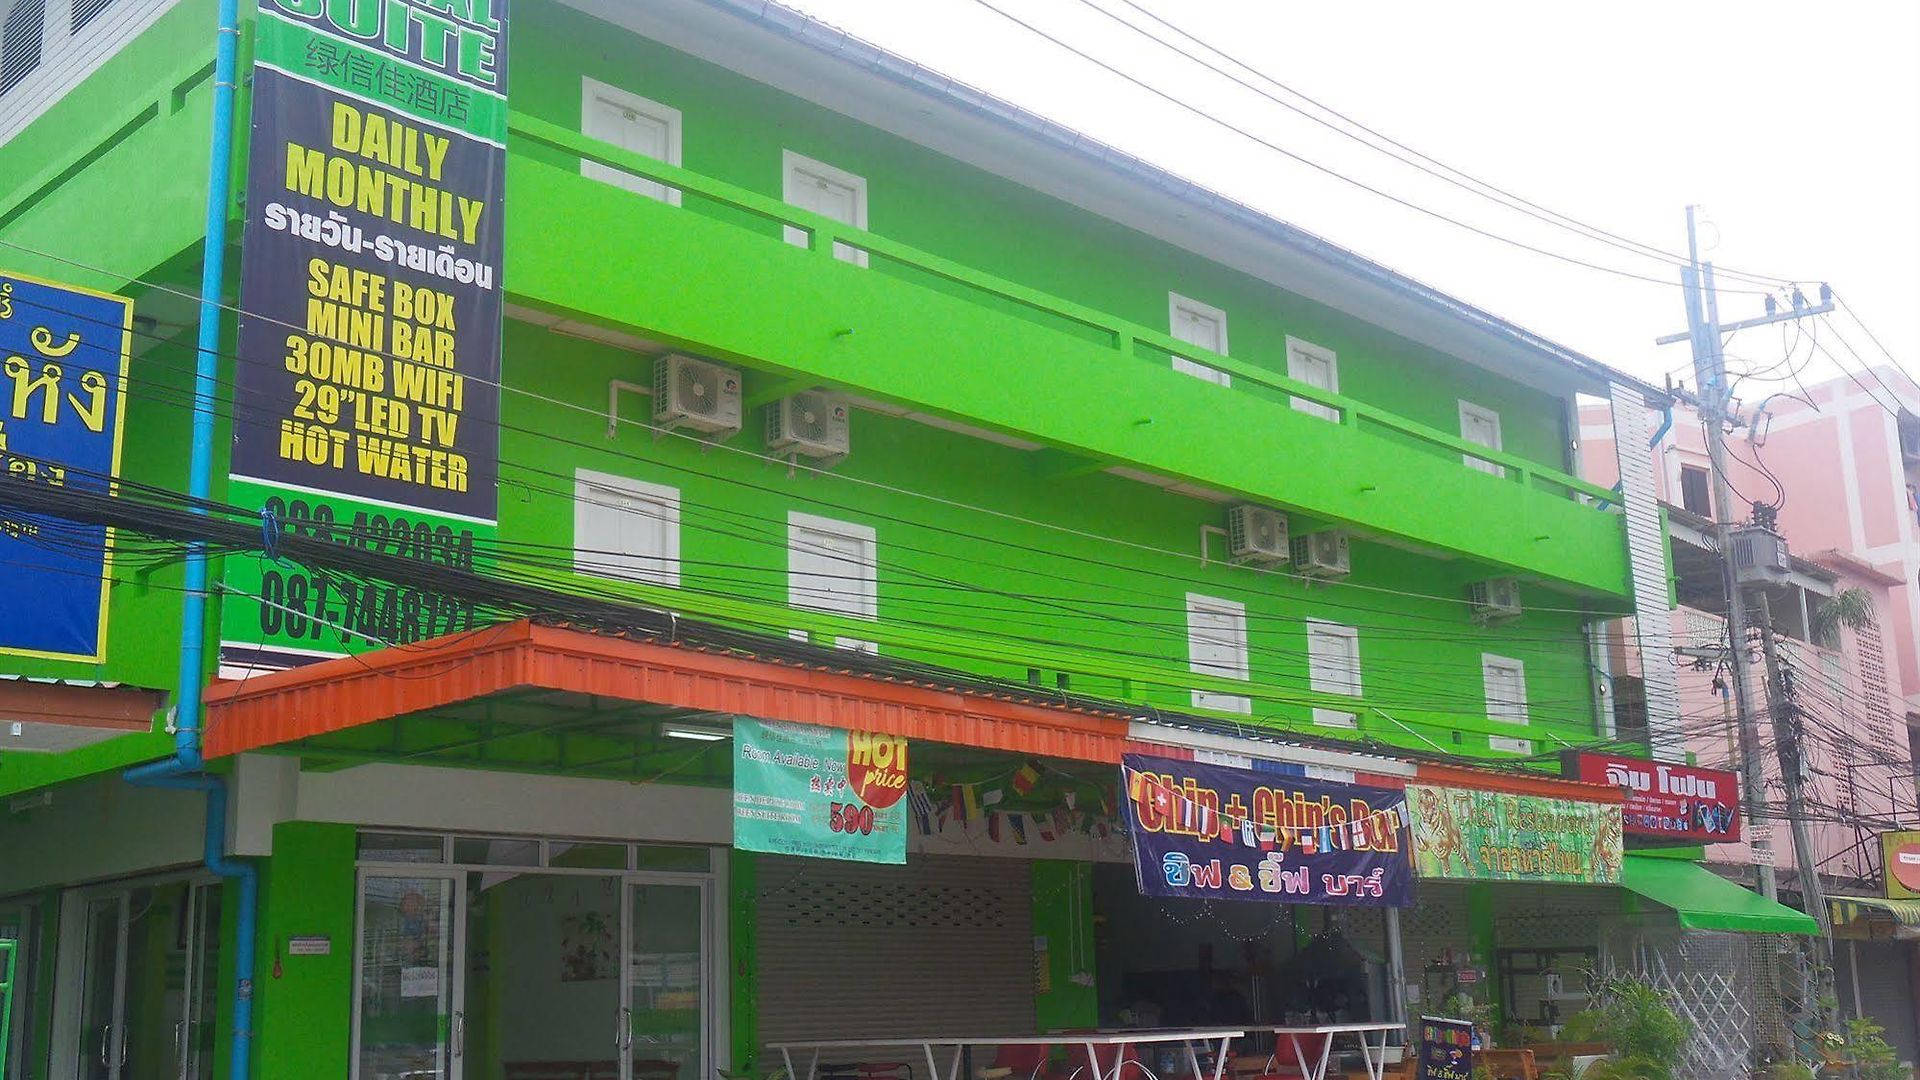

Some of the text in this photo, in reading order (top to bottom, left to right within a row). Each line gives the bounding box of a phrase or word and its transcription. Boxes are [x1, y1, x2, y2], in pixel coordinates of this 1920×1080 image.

[303, 37, 471, 124] 绿信佳酒店
[332, 101, 449, 181] DAILY
[285, 142, 484, 245] MONTHLY
[264, 202, 493, 290] รายวัน-รายเดือน
[308, 258, 455, 331] SAFE BOX
[307, 299, 455, 369] MINI BAR
[285, 335, 463, 412] 30MB WIFI
[279, 419, 468, 492] HOT WATER
[418, 406, 458, 448] TV
[742, 744, 846, 773] Room Available Now
[853, 730, 907, 770] HOT
[860, 769, 906, 797] price
[830, 801, 874, 836] 590
[1137, 771, 1219, 842] Chip
[1229, 864, 1254, 891] &
[1322, 867, 1384, 898] บาร์
